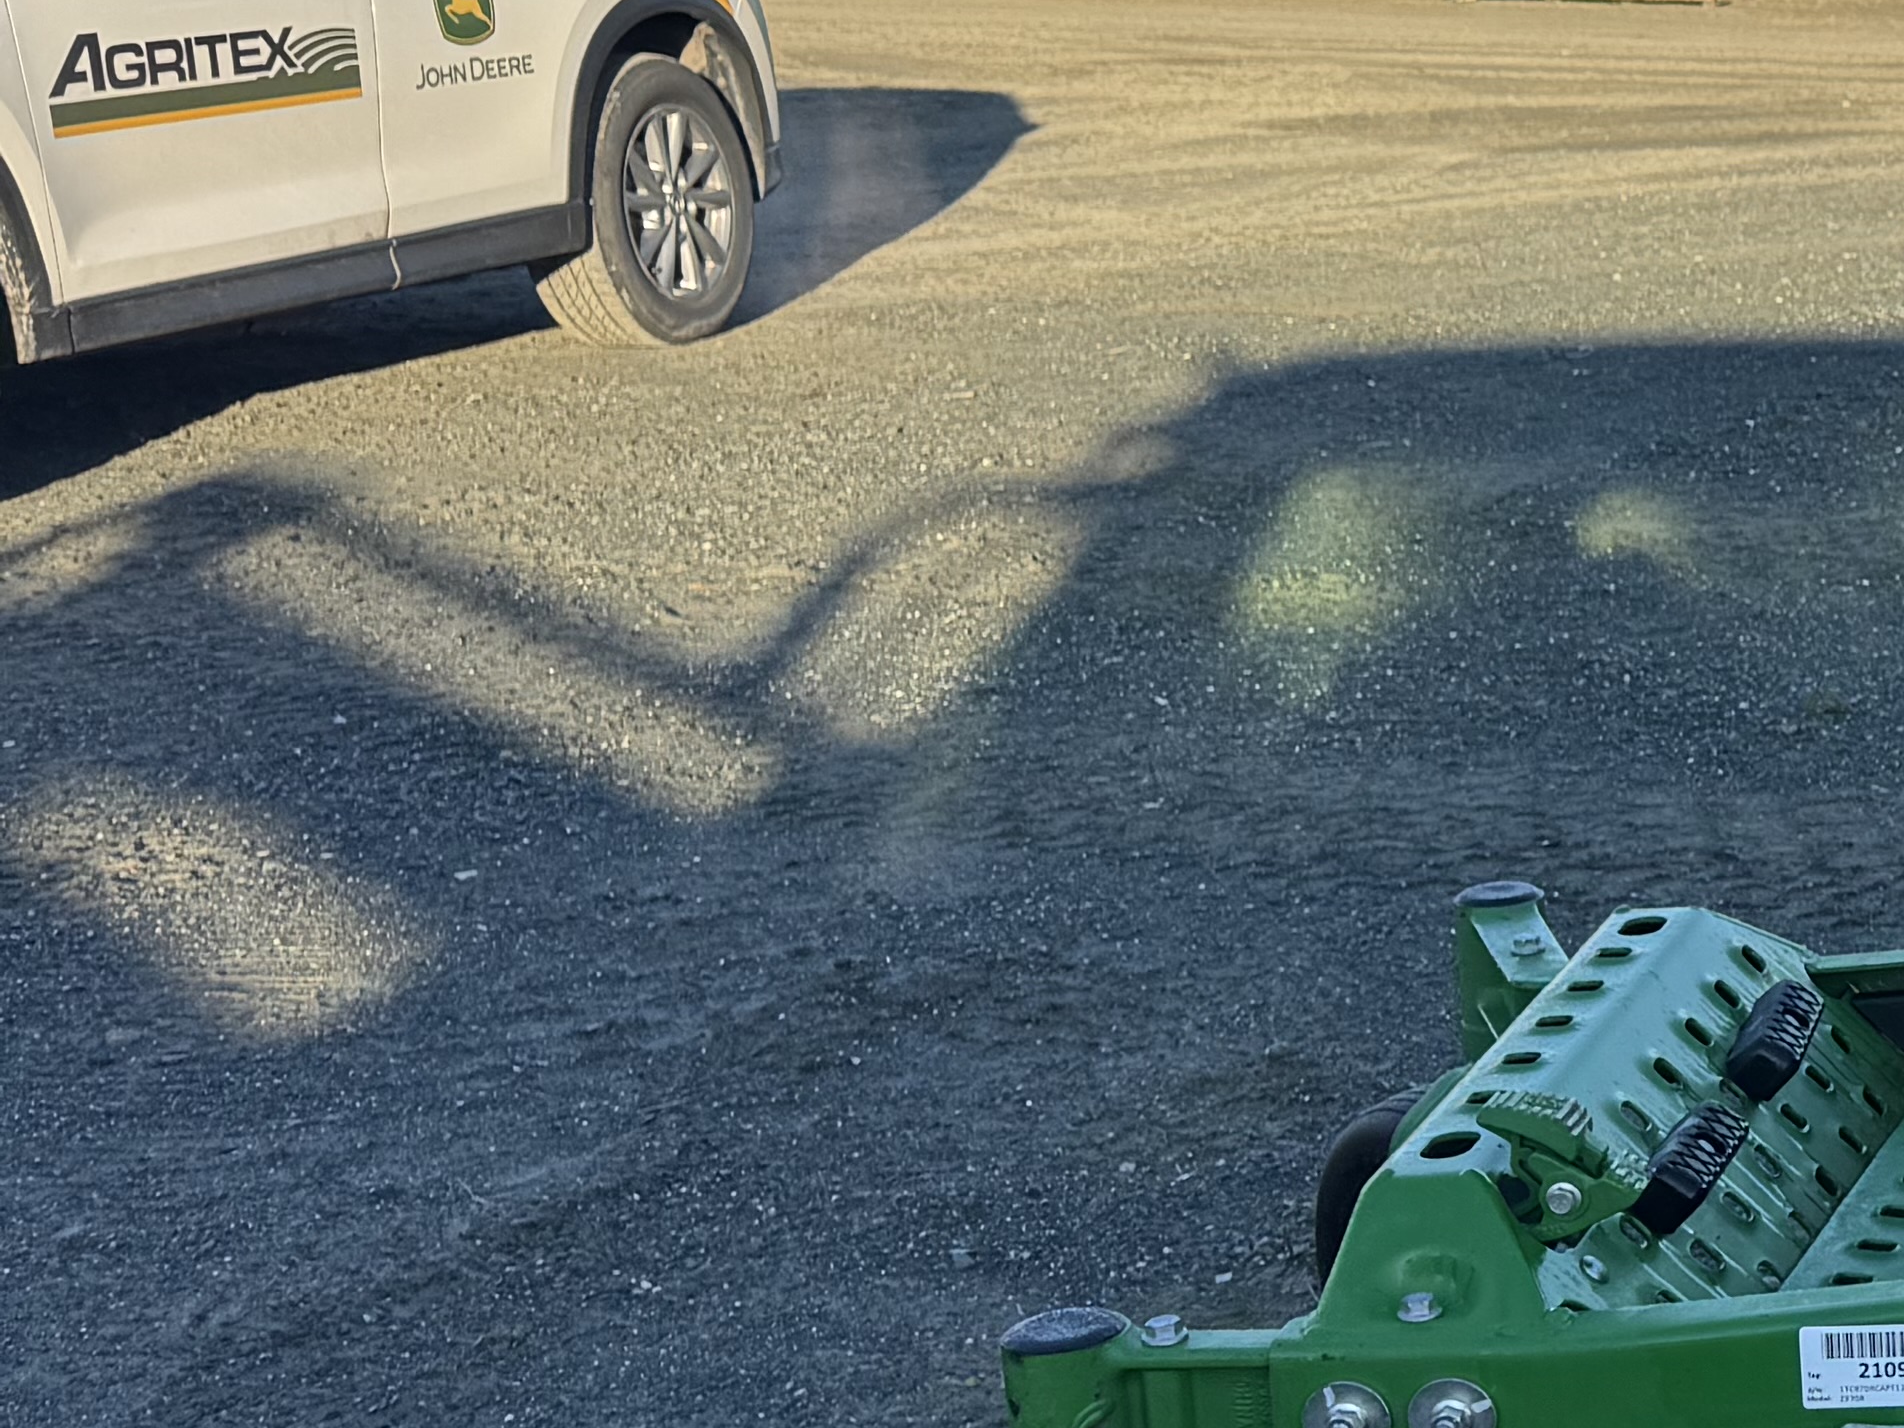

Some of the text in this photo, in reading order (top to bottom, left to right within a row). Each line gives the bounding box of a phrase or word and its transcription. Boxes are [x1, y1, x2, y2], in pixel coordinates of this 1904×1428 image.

[49, 26, 299, 99] AGRITEX
[416, 54, 535, 90] JOHN DEERE
